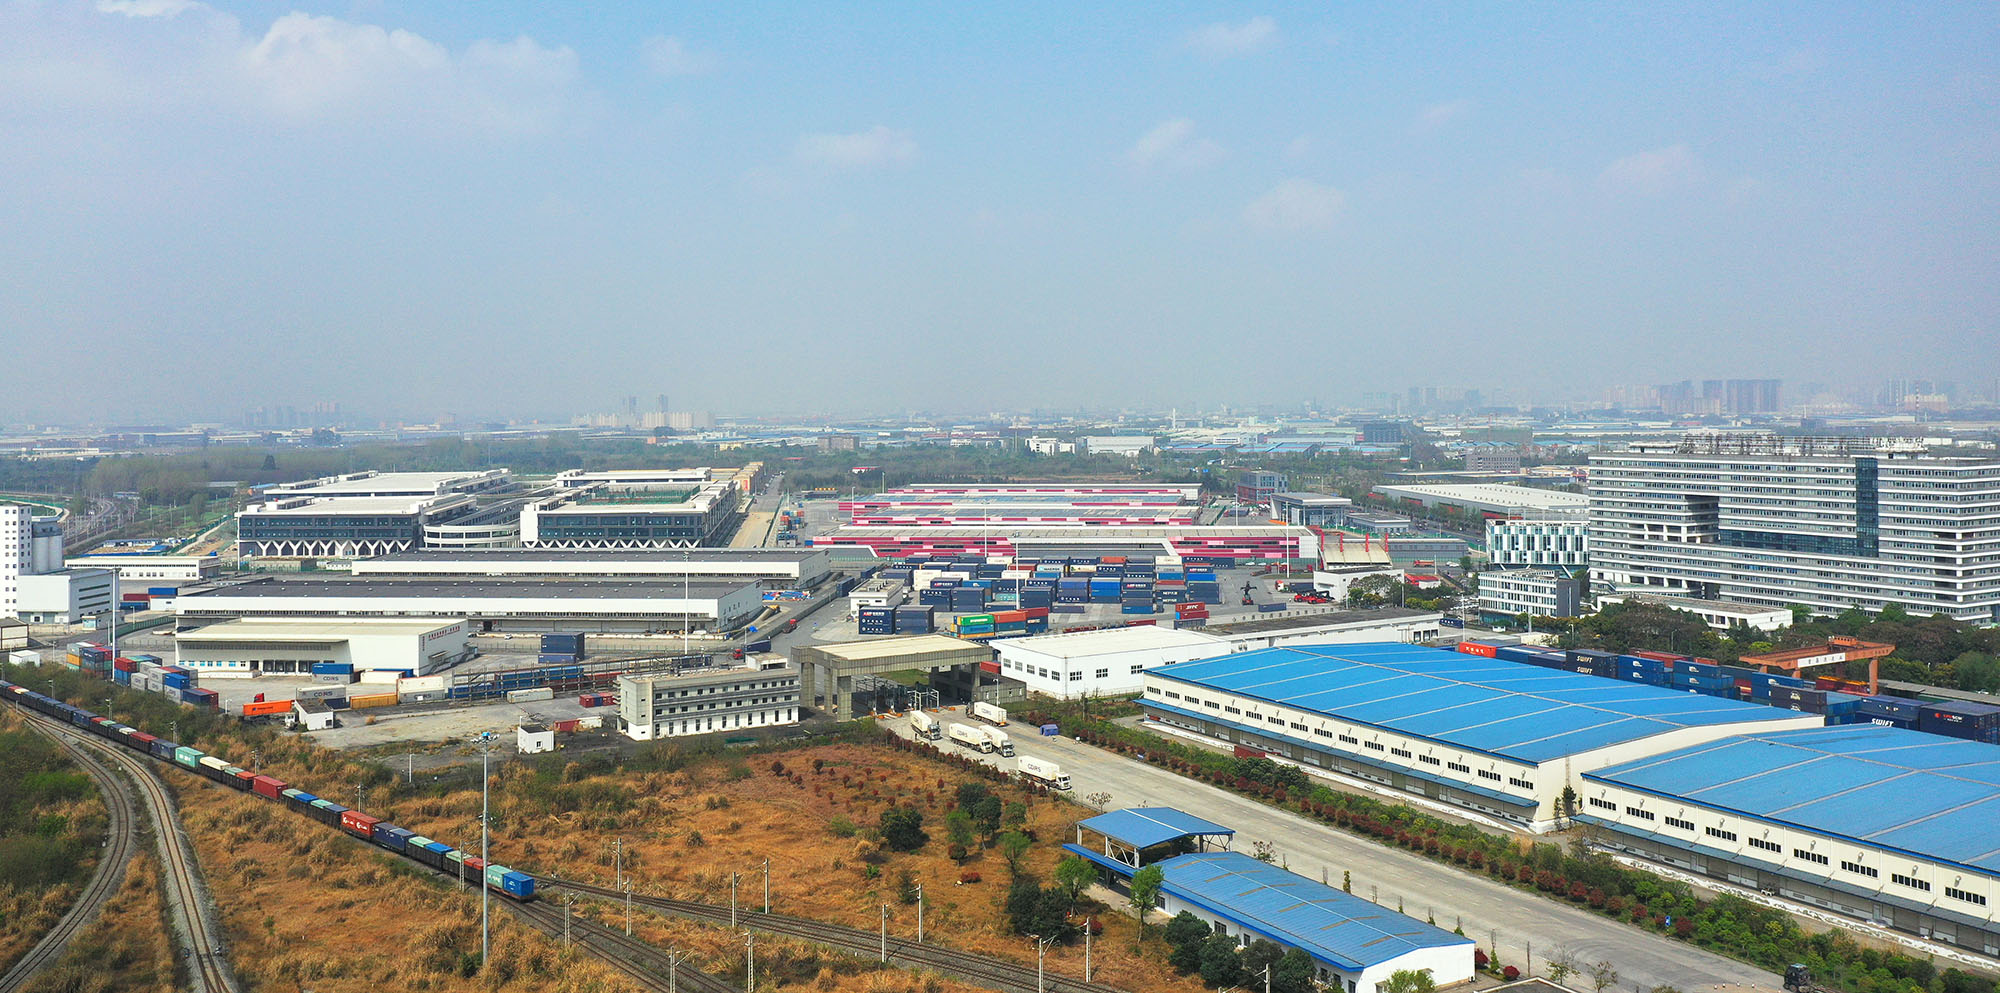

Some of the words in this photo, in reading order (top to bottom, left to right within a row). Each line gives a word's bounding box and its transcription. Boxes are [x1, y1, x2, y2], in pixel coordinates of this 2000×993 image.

[1576, 655, 1593, 663] SWIFT
[1576, 666, 1593, 674] SWIFT
[1871, 718, 1894, 727] SWIFT
